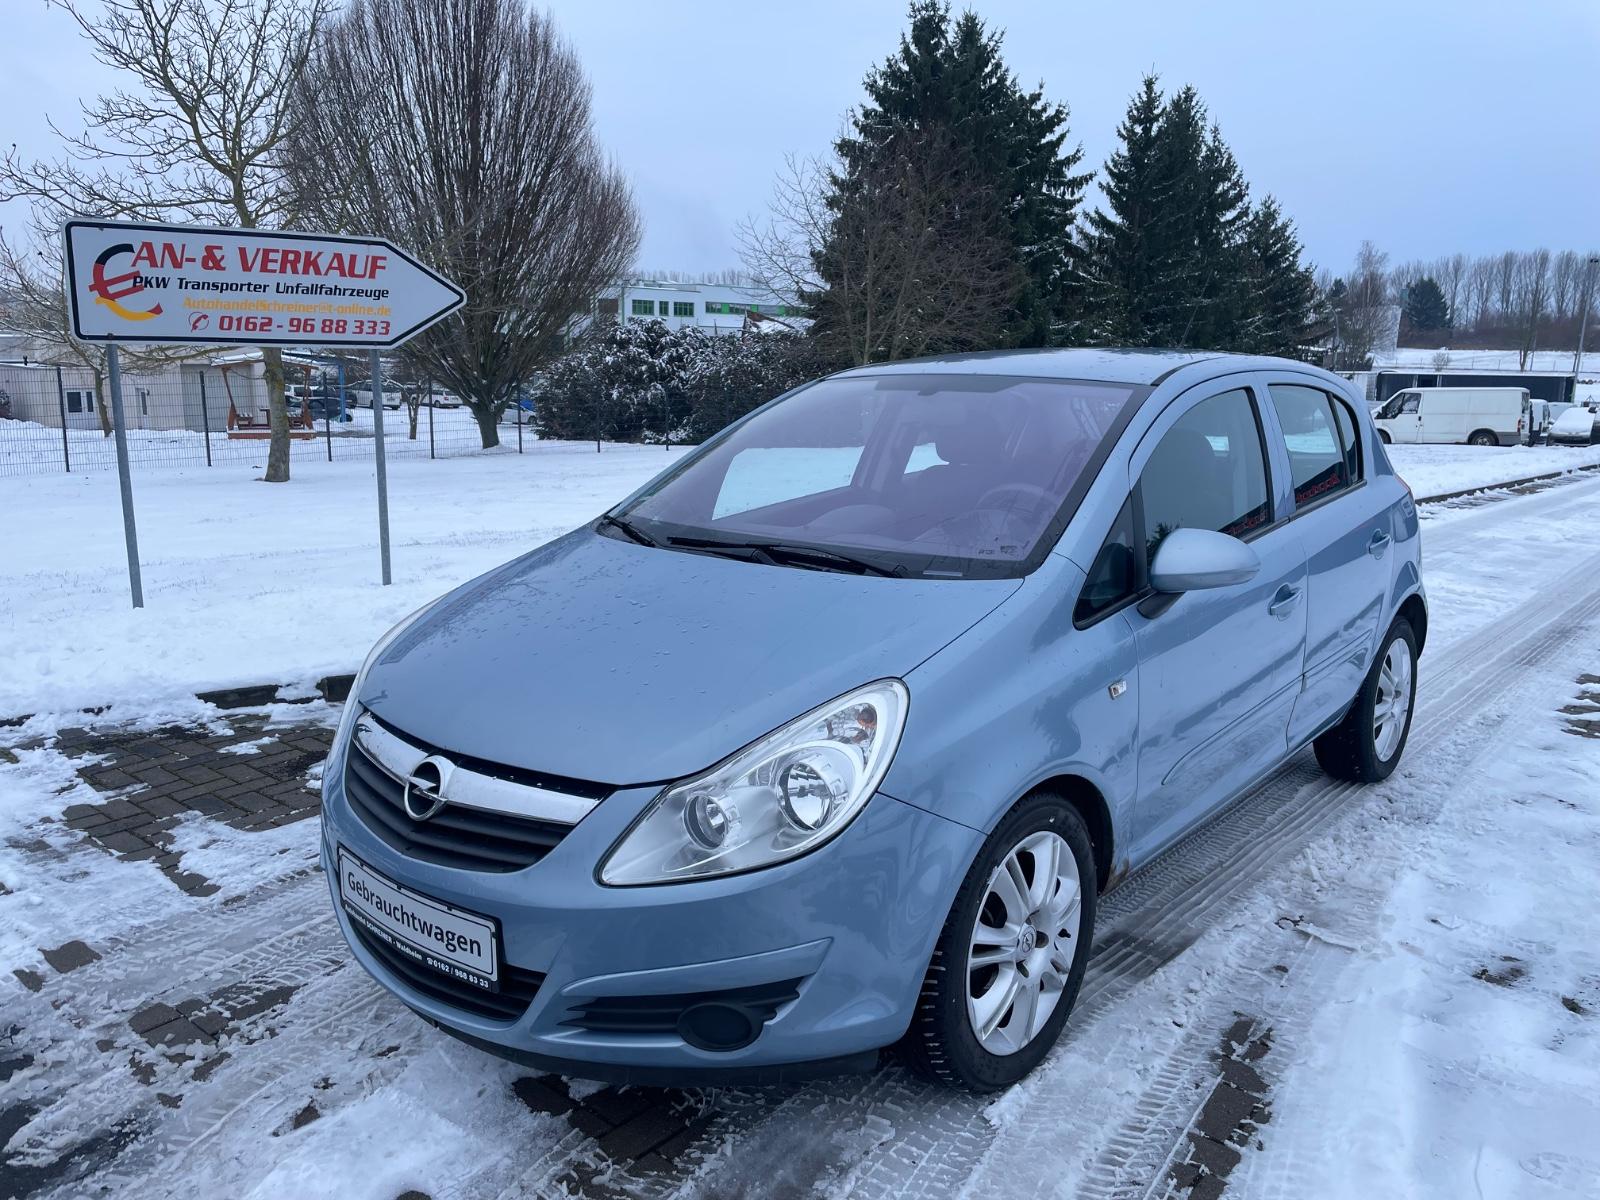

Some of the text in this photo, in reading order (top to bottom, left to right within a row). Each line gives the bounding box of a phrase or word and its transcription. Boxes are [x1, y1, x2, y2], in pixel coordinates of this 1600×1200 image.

[131, 241, 388, 279] AN- & VERKAUF
[132, 275, 390, 301] PKW Transporter Unfallfahrzeuge
[347, 871, 482, 957] Gebrauchtwagen
